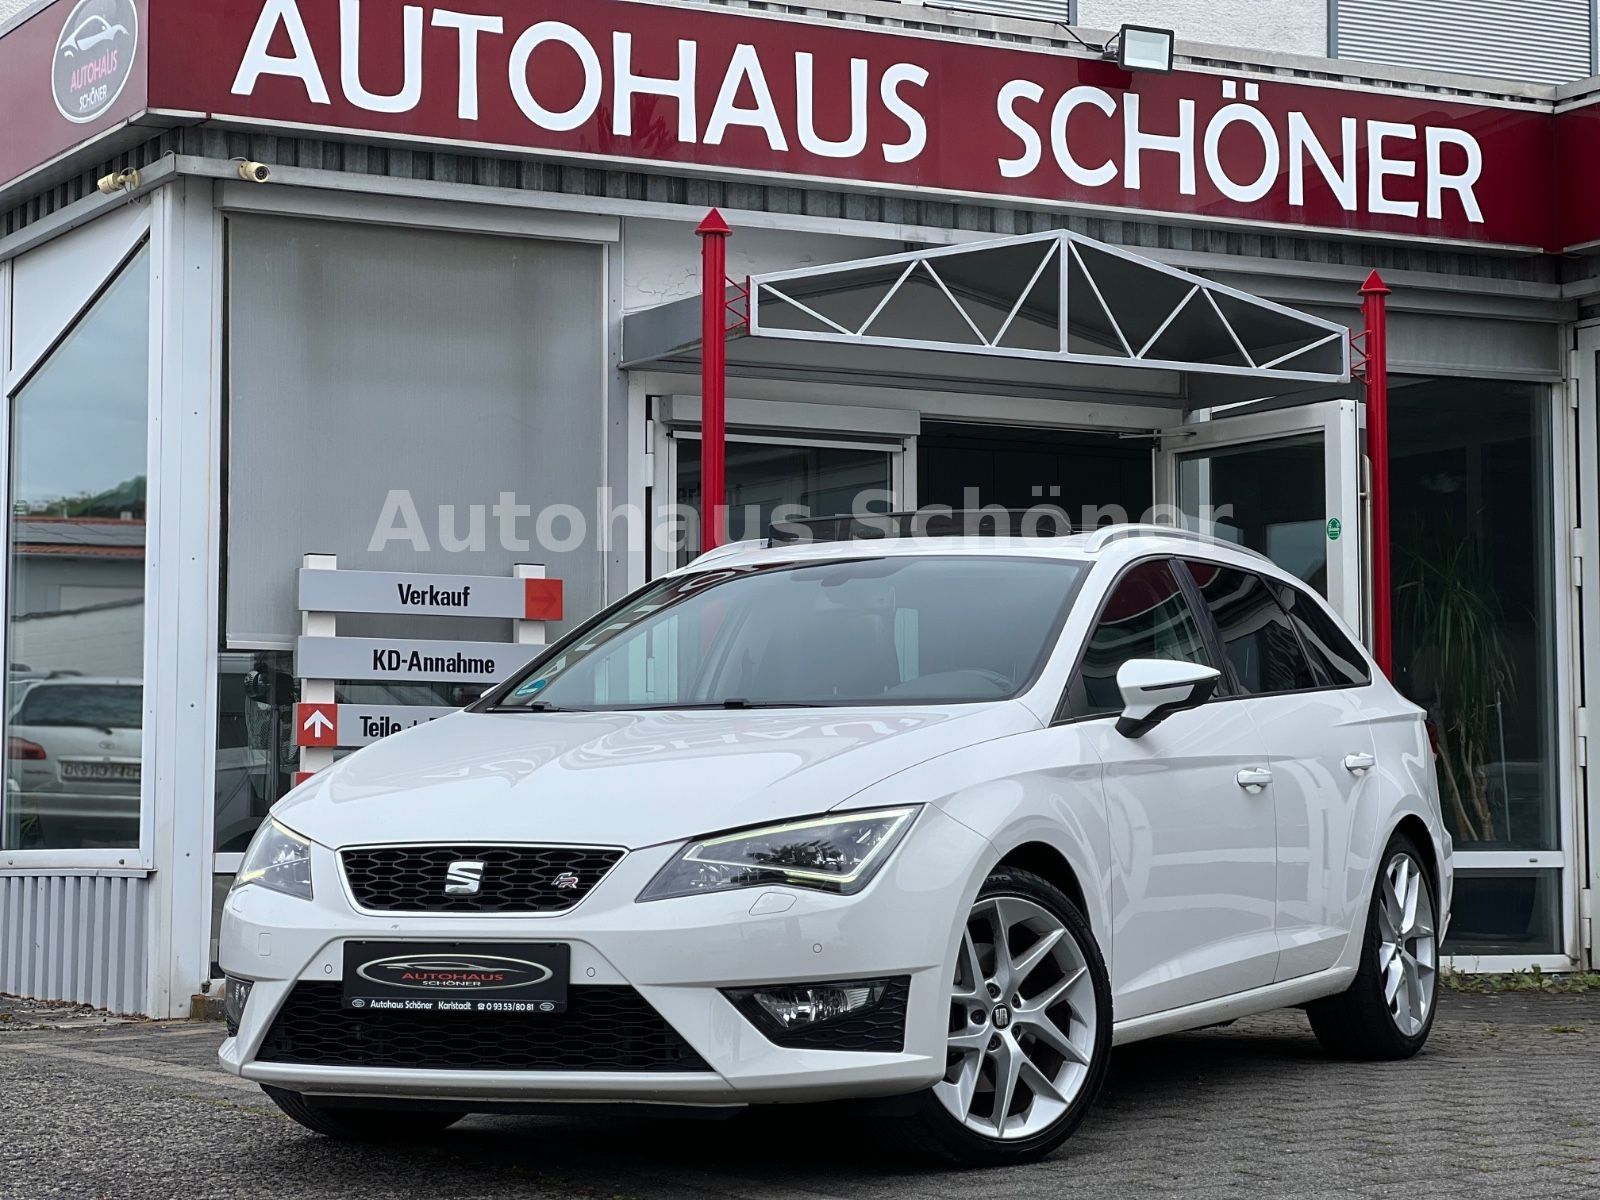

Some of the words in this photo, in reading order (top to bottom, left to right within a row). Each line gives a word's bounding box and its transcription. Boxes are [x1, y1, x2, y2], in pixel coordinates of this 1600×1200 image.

[70, 48, 119, 93] AUTOHAUS
[79, 84, 108, 110] SCHÖNER
[230, 0, 930, 164] AUTOHAUS
[997, 79, 1485, 223] SCHÖNER
[397, 583, 471, 607] Verkauf
[372, 649, 495, 674] KD-Annahme
[359, 715, 402, 738] Teile
[401, 972, 504, 981] AUTOHAUS
[370, 1000, 404, 1009] Autohaus
[405, 1000, 433, 1010] Schöner
[438, 1001, 472, 1010] Karlstadt
